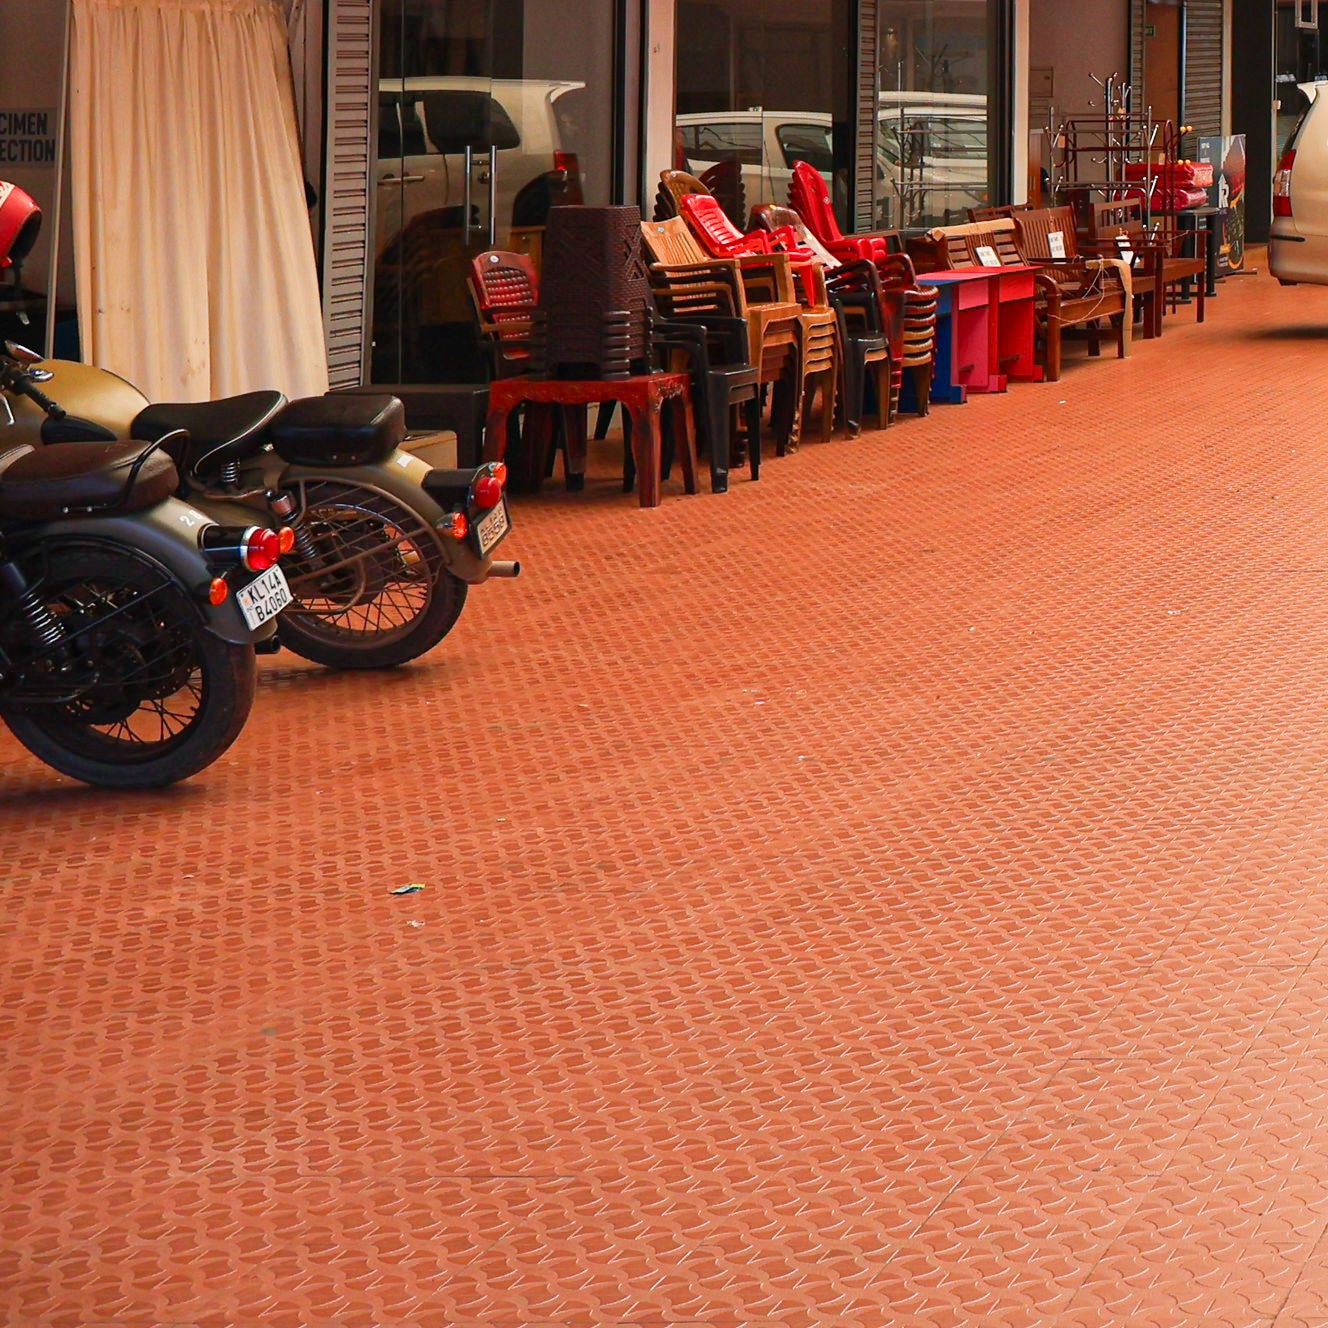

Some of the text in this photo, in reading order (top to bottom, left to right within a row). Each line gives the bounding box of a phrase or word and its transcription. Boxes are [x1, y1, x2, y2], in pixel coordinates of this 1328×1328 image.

[0, 112, 48, 135] CIMEN
[0, 139, 56, 162] ECTION
[255, 588, 288, 622] B4060
